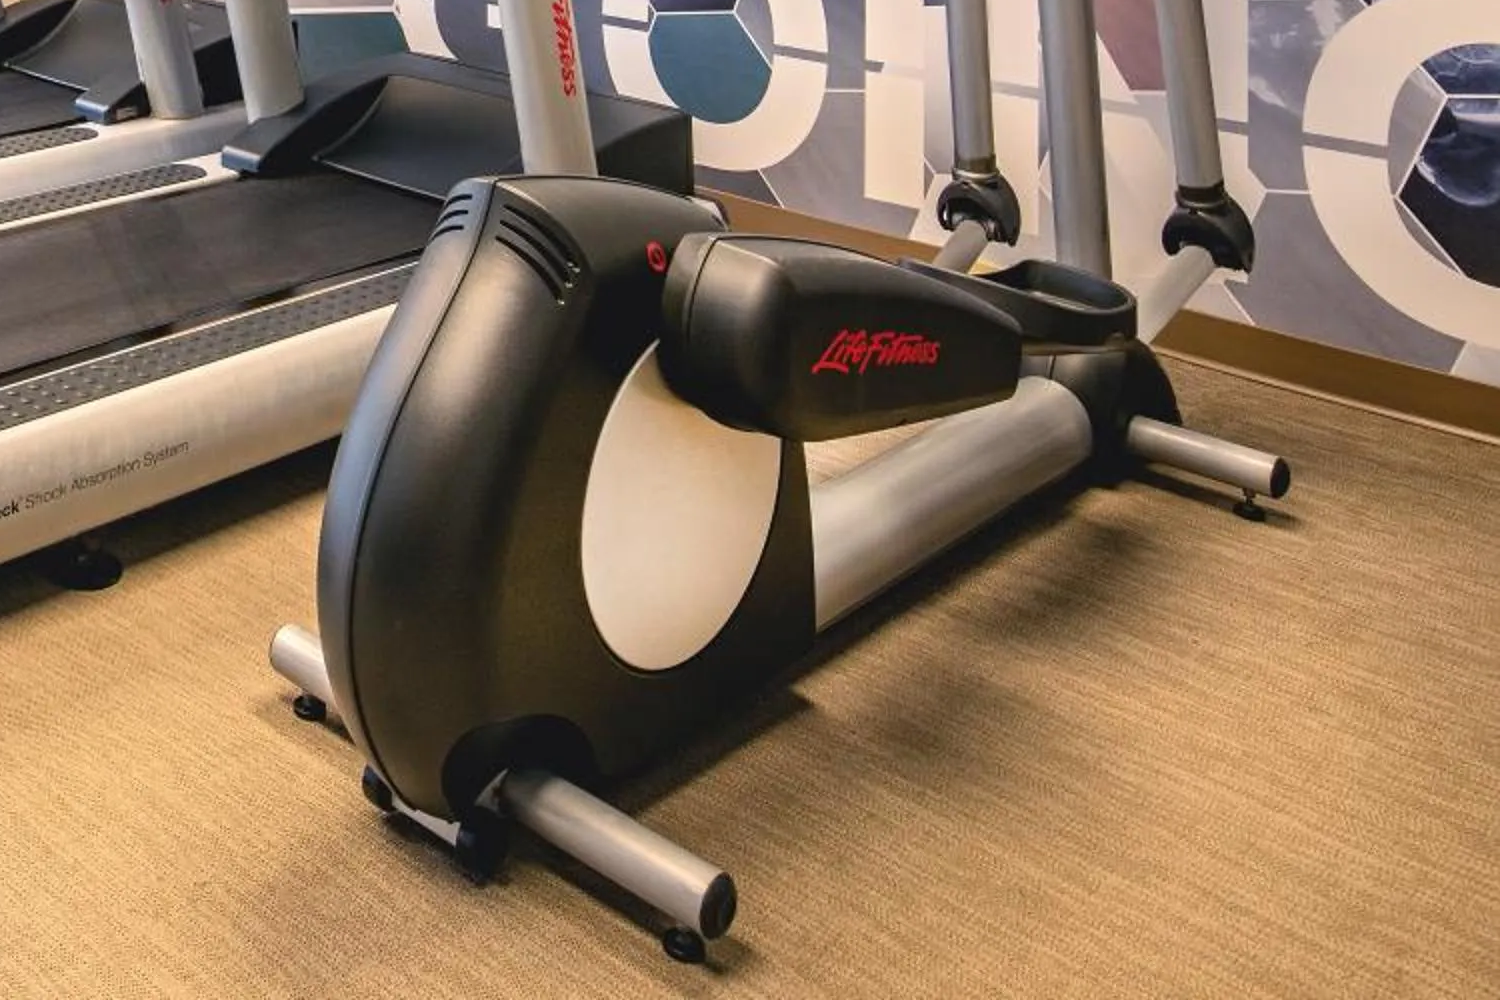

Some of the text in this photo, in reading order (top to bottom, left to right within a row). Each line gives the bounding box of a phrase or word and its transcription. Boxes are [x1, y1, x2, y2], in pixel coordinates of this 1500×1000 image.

[24, 482, 68, 510] Shock
[71, 458, 142, 492] Absorption
[143, 441, 190, 469] System
